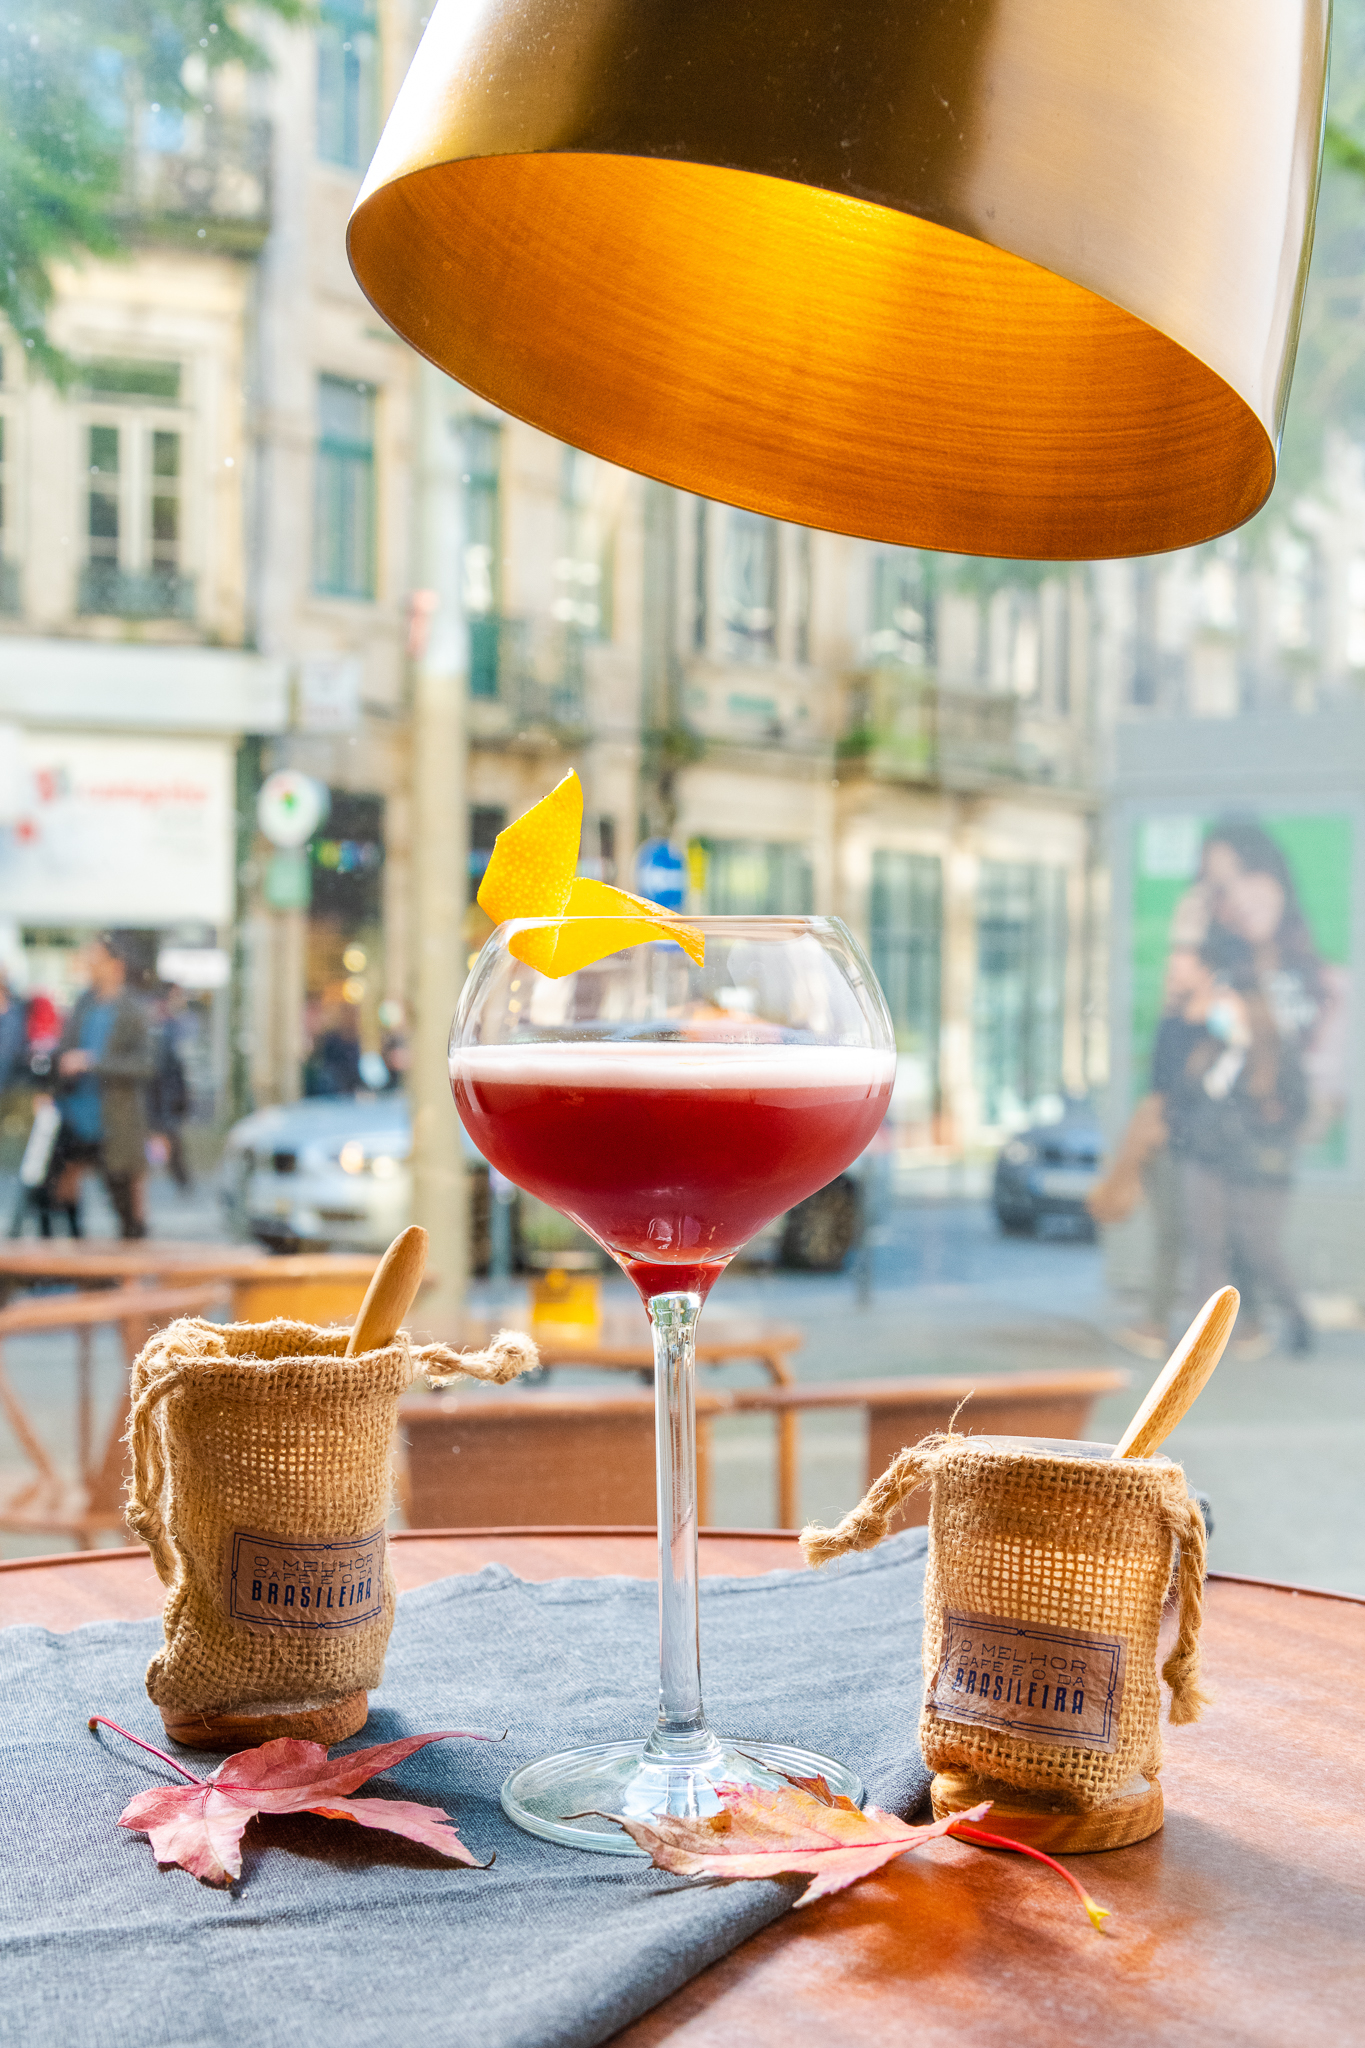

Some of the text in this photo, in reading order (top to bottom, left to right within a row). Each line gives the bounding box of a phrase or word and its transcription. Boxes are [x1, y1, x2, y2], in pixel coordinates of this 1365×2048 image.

[254, 1553, 373, 1572] O MELHOR
[341, 1573, 353, 1584] O
[252, 1577, 372, 1608] BRASILEIRA
[960, 1639, 1087, 1674] O MELHOR
[952, 1667, 1084, 1715] BRASILEIRA
[1032, 1669, 1046, 1680] O
[1057, 1674, 1086, 1688] DA
